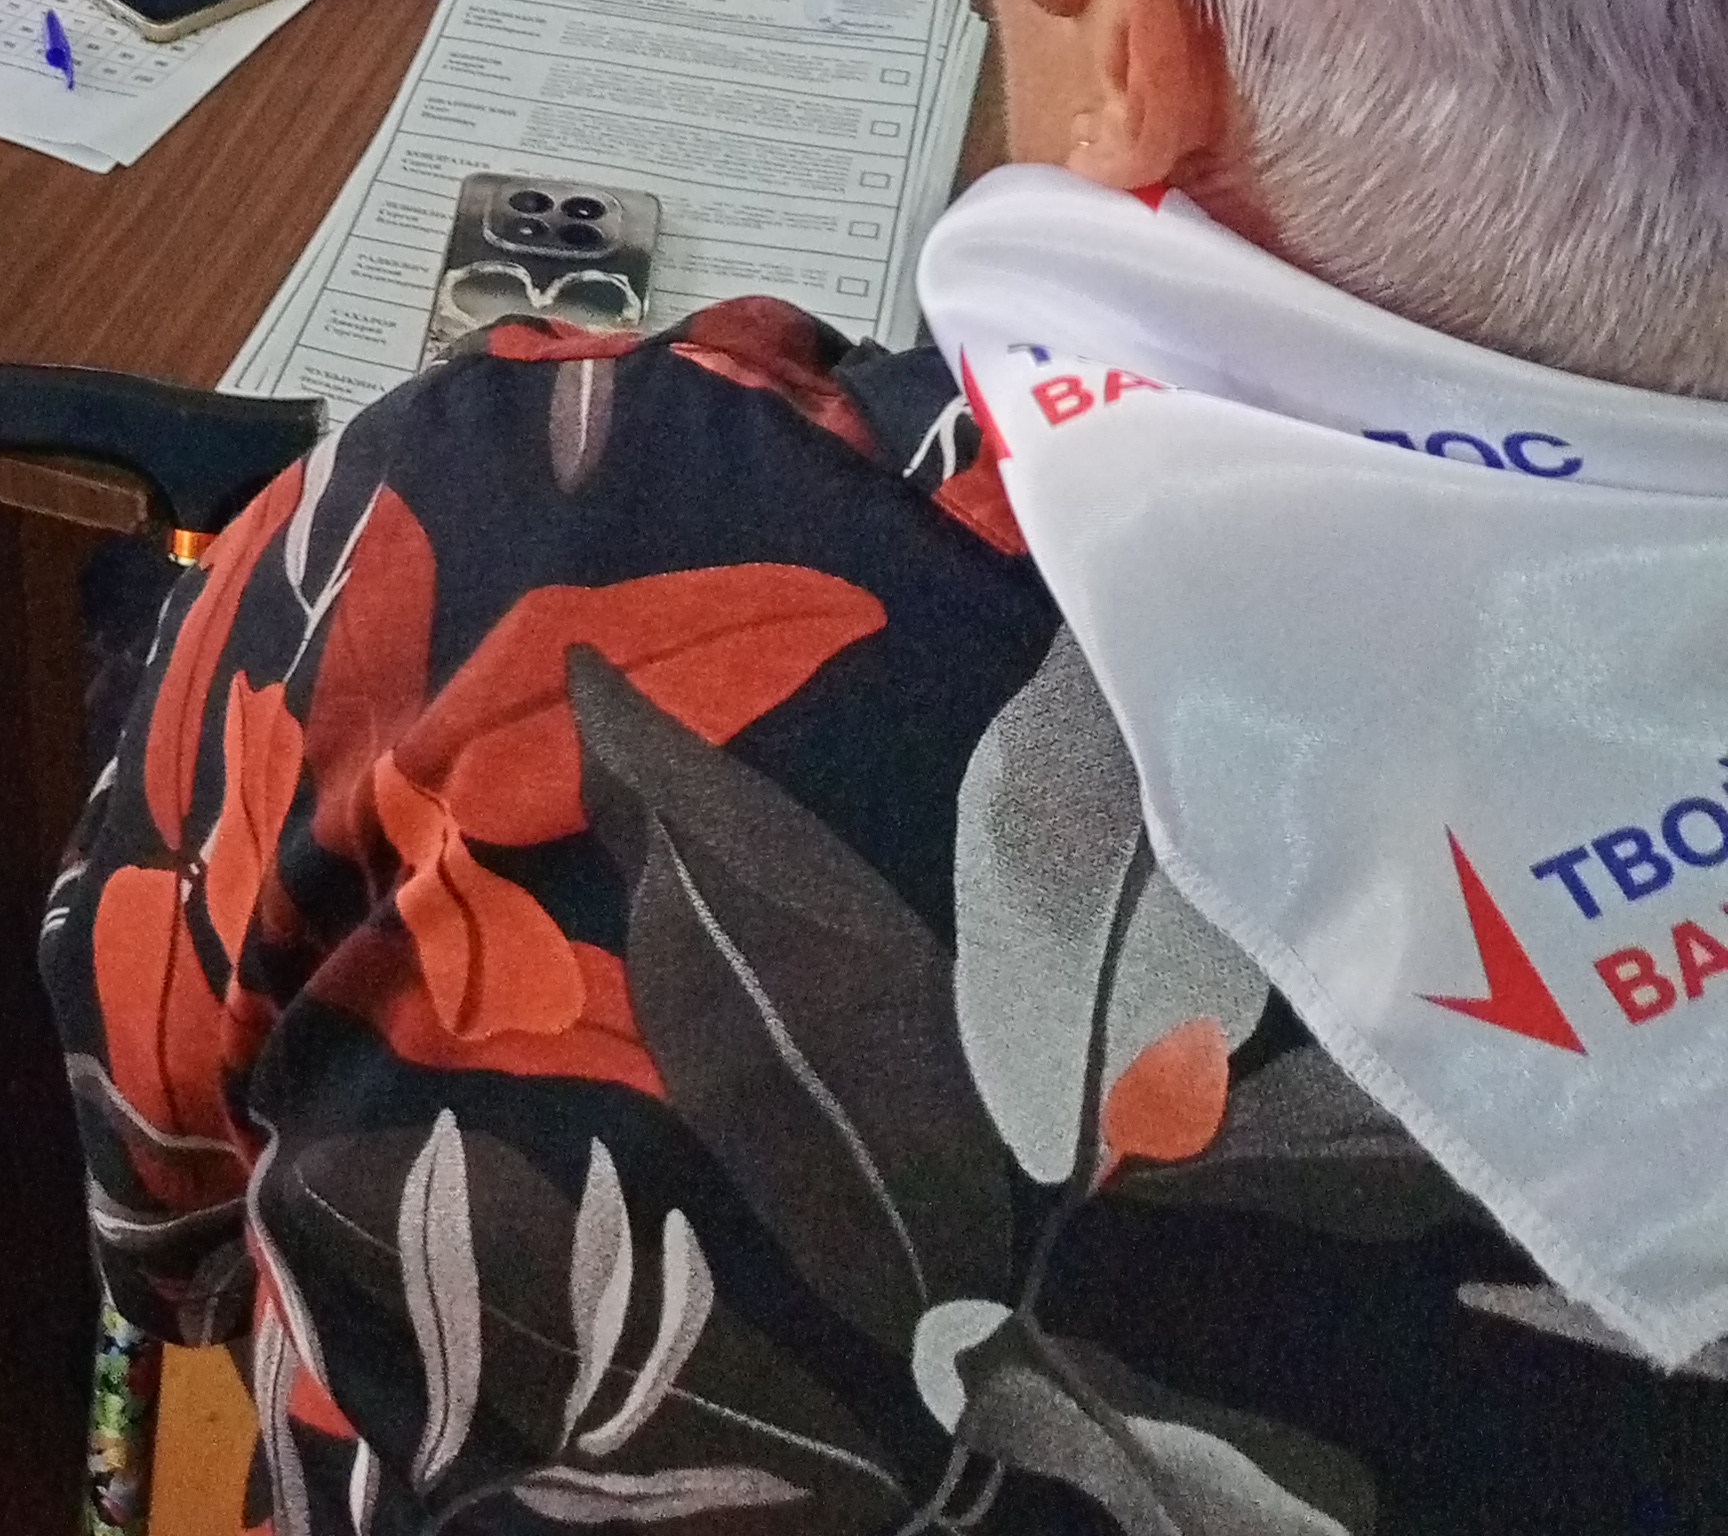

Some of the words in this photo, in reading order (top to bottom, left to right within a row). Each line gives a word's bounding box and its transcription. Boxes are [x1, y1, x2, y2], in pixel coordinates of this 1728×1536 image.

[1031, 367, 1167, 427] ВА
[1529, 757, 1728, 921] ТВО
[1593, 901, 1728, 1026] ВА
